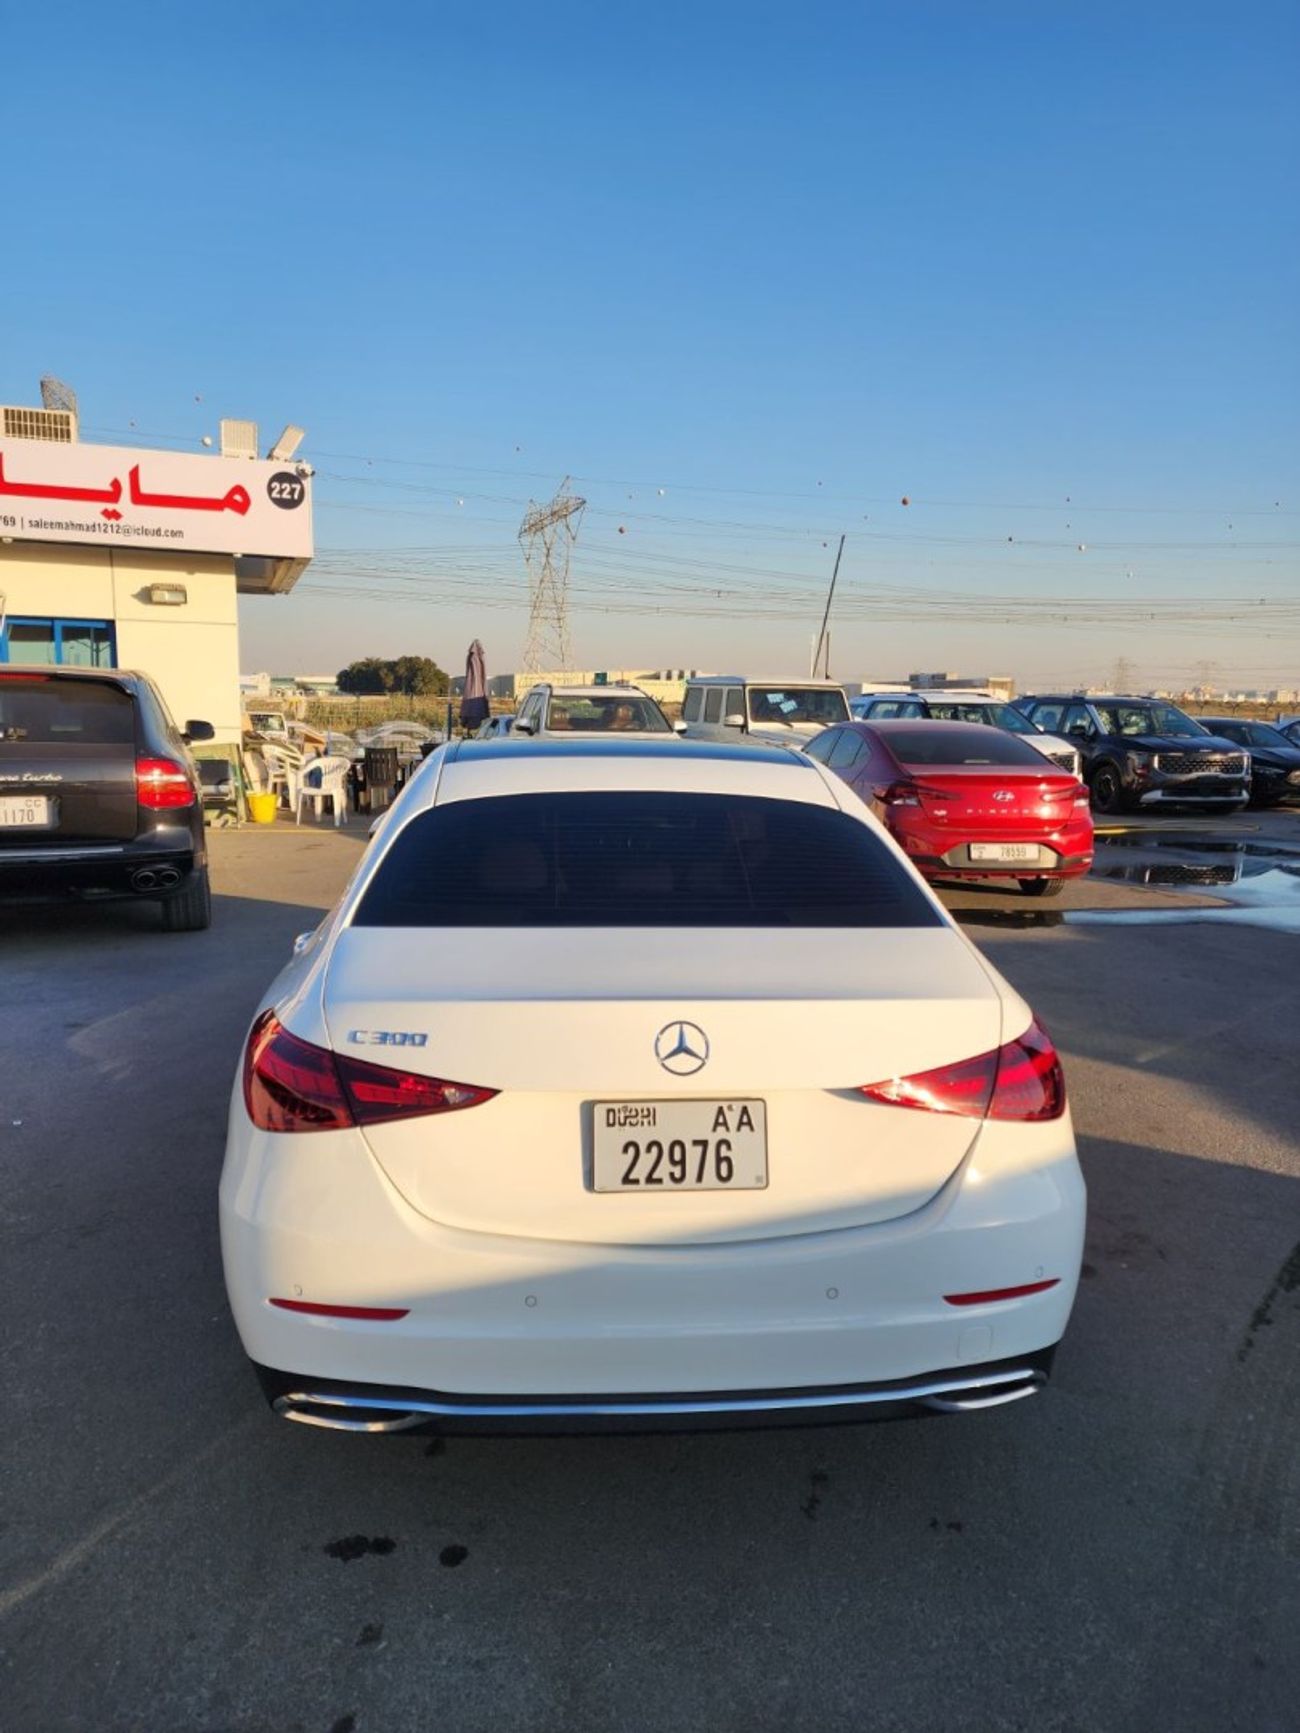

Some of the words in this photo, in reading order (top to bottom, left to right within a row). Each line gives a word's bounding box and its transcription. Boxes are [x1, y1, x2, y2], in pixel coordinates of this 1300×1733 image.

[271, 482, 301, 500] 227
[28, 518, 184, 538] saleemahmad1212@icloud.com
[621, 1139, 734, 1185] 22976
